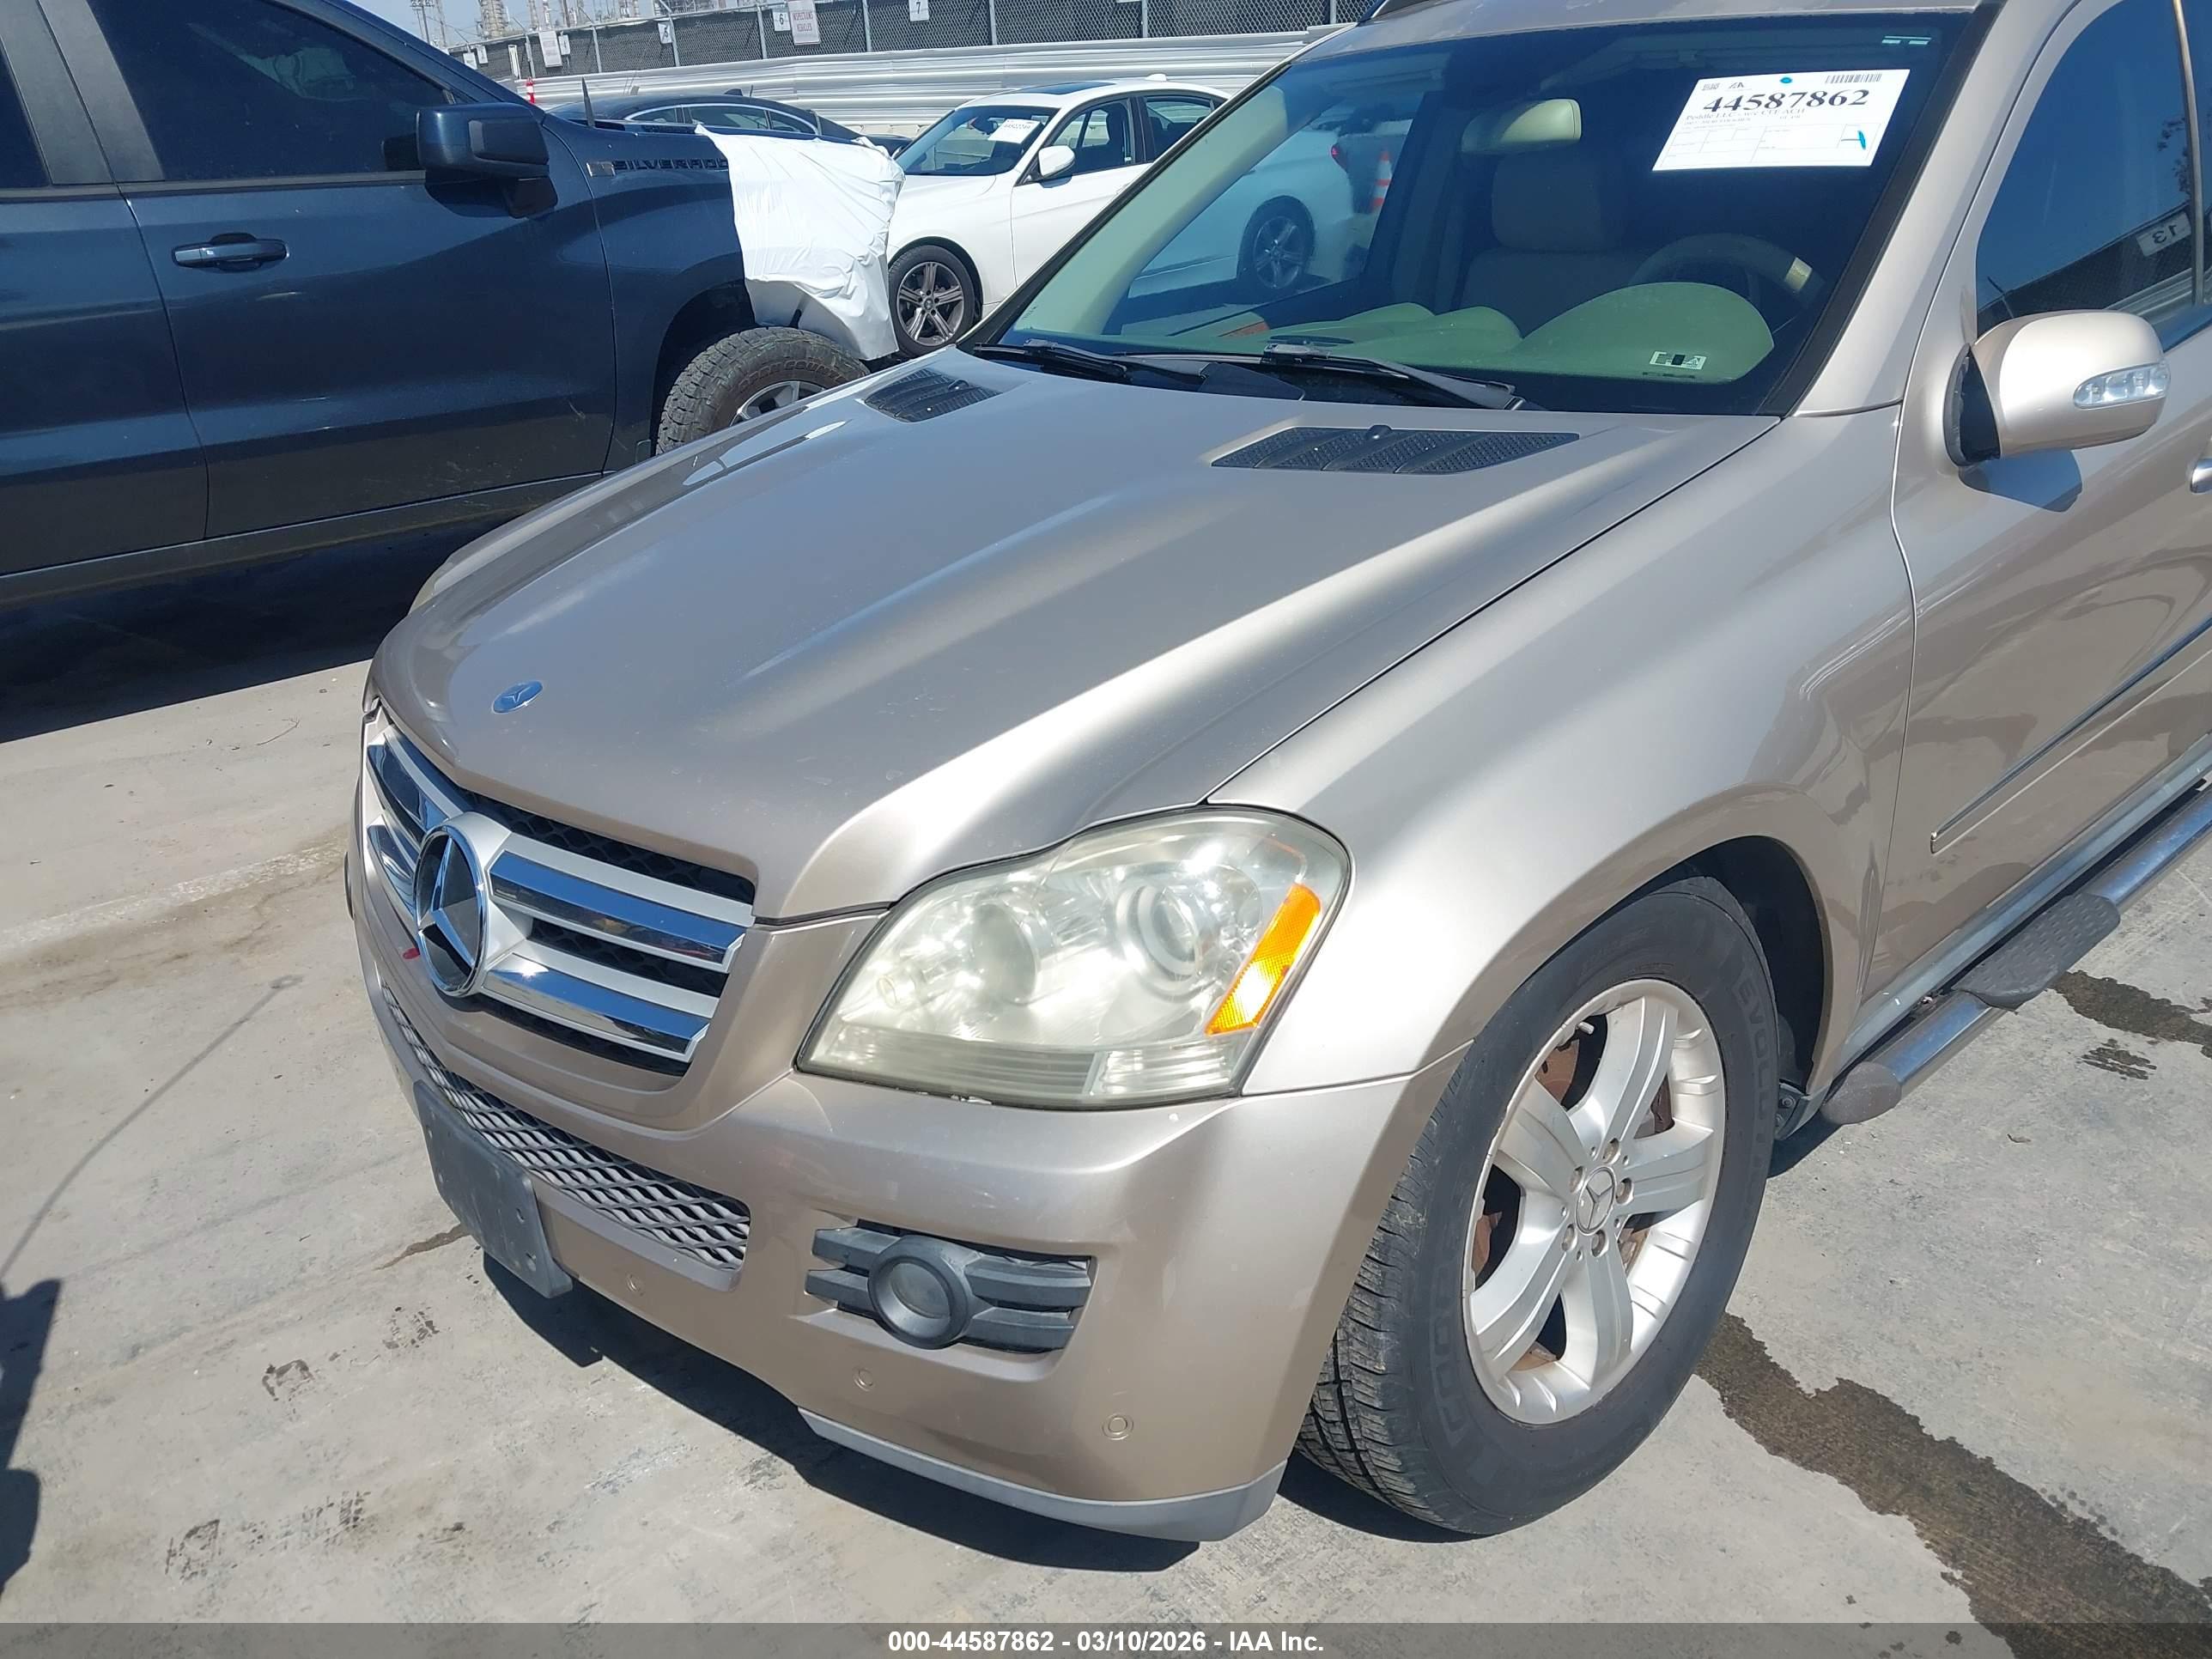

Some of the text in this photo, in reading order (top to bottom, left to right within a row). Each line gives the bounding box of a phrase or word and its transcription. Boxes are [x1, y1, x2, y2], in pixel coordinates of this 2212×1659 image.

[915, 2, 921, 15] 7
[779, 14, 785, 26] 6
[1703, 89, 1869, 113] 44587862
[613, 158, 729, 171] SILVERADO
